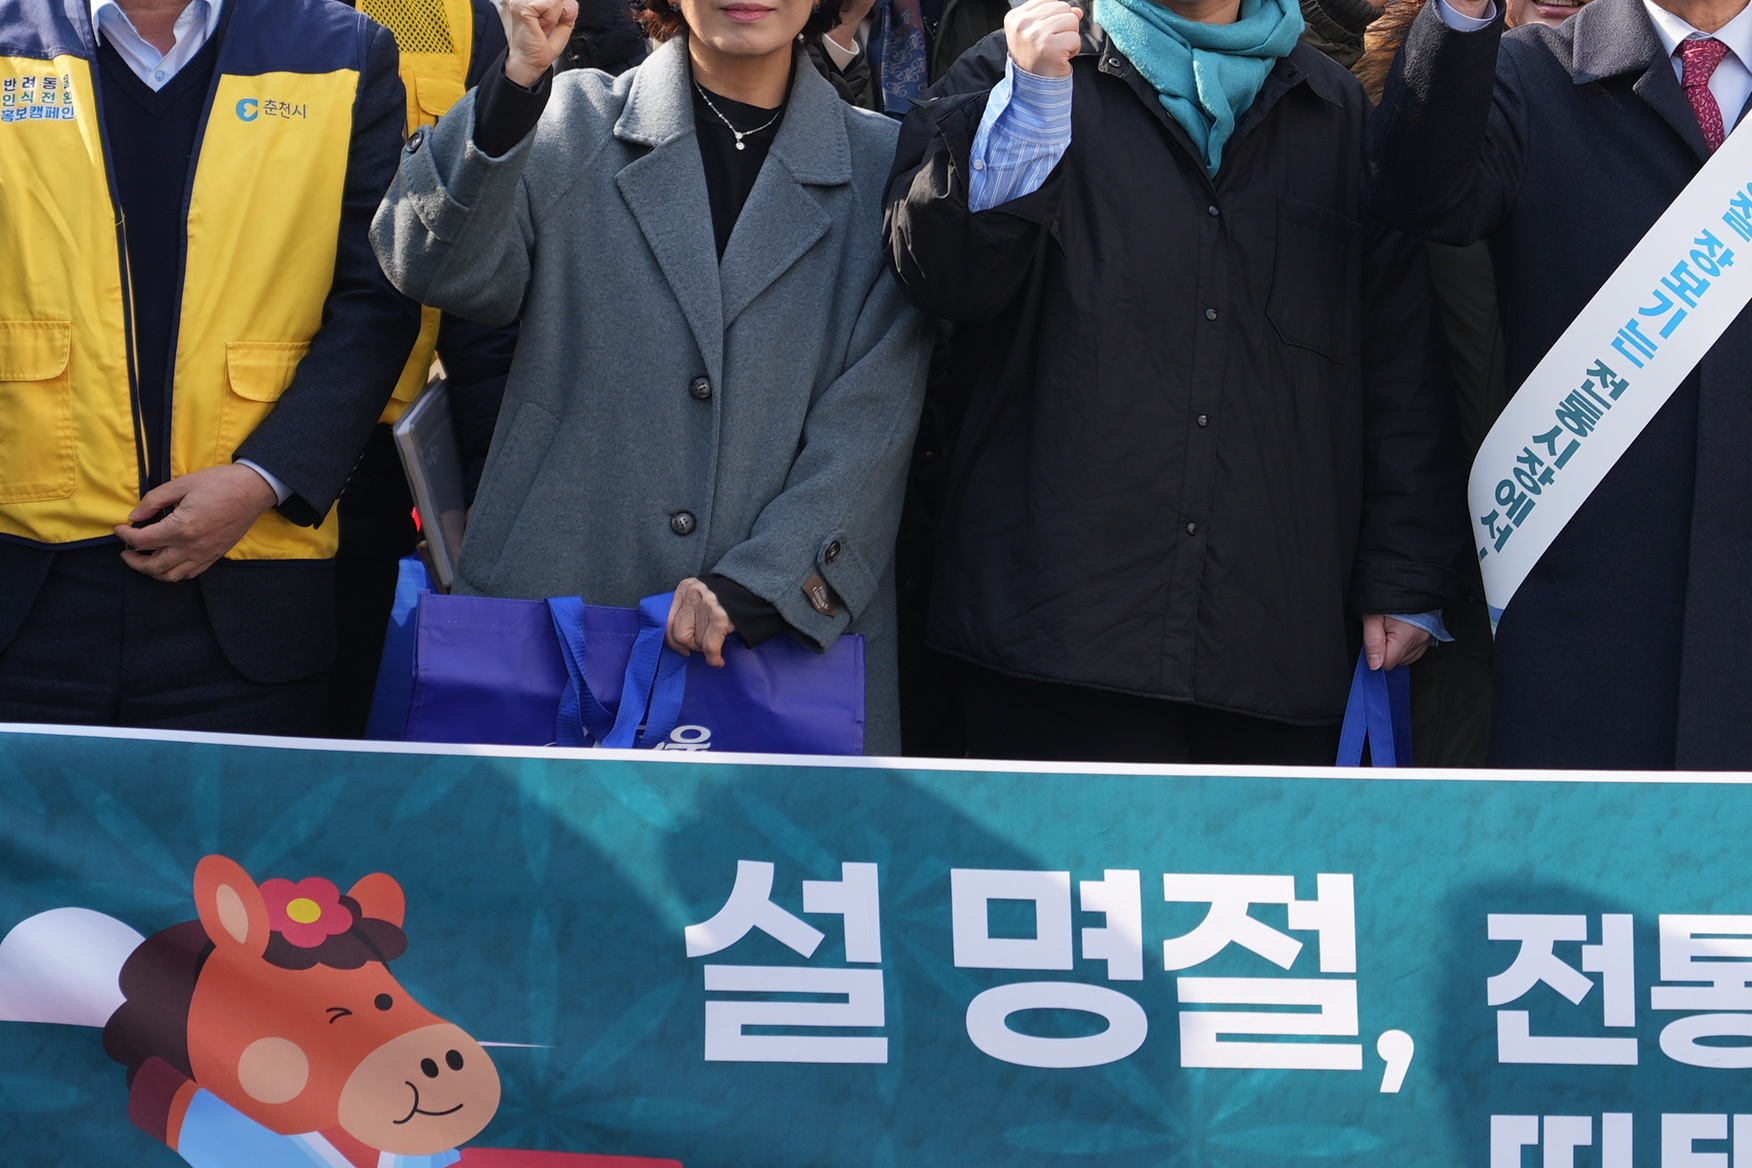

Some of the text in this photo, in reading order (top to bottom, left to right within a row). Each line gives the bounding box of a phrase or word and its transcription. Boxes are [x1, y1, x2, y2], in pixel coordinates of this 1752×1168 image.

[1, 106, 75, 122] 홍보캠페인
[263, 99, 306, 119] 춘천시
[1611, 228, 1735, 369] 장보기는
[684, 860, 889, 1064] 설
[950, 868, 1416, 1094] 명절,
